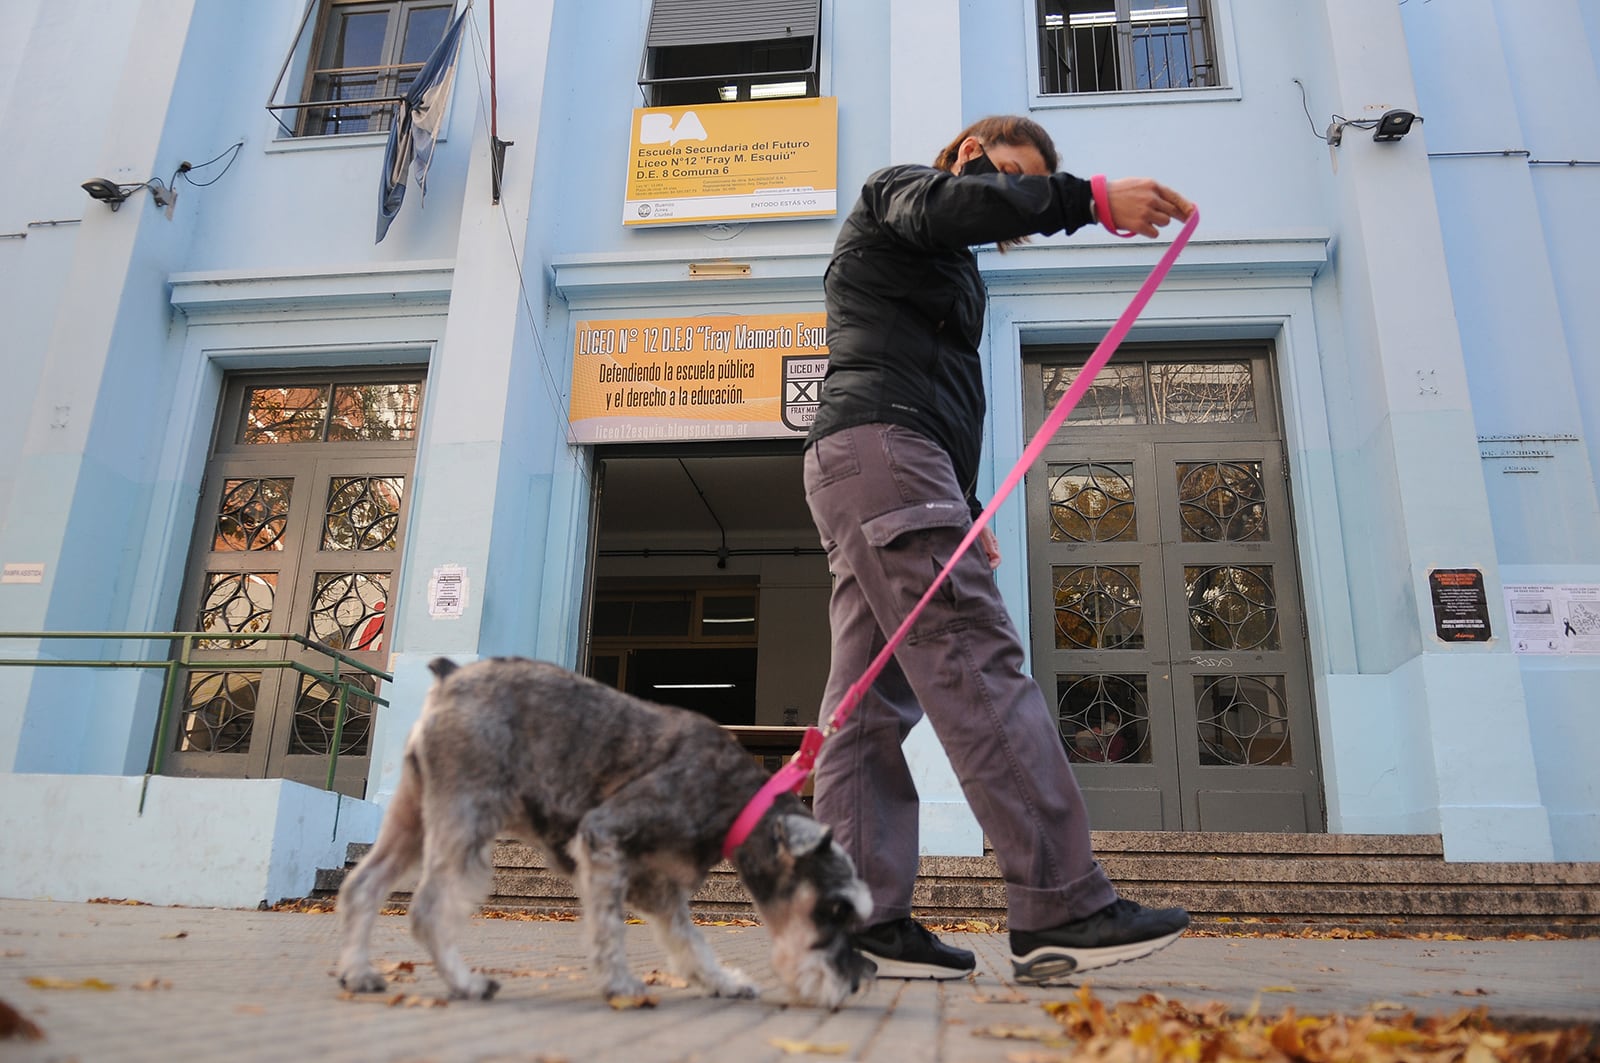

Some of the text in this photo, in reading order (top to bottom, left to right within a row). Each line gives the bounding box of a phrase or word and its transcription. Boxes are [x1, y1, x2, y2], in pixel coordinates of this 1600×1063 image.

[640, 111, 708, 146] BA
[638, 140, 810, 157] Escuela Secundaria del Futuro
[637, 160, 668, 168] Liceo
[700, 156, 731, 165] "Fray
[734, 154, 747, 162] M.
[751, 151, 796, 163] Esquiú"
[636, 166, 729, 179] D.E. 8 Comuna 6
[579, 329, 616, 355] LICEO
[643, 327, 659, 353] 12
[661, 326, 694, 352] D.E.8
[734, 324, 793, 349] Mamerto
[796, 322, 827, 350] Esqu
[599, 359, 755, 383] Defendiendo la escuela pública
[790, 364, 813, 374] LICEO
[606, 384, 745, 411] y el derecho a la educación.
